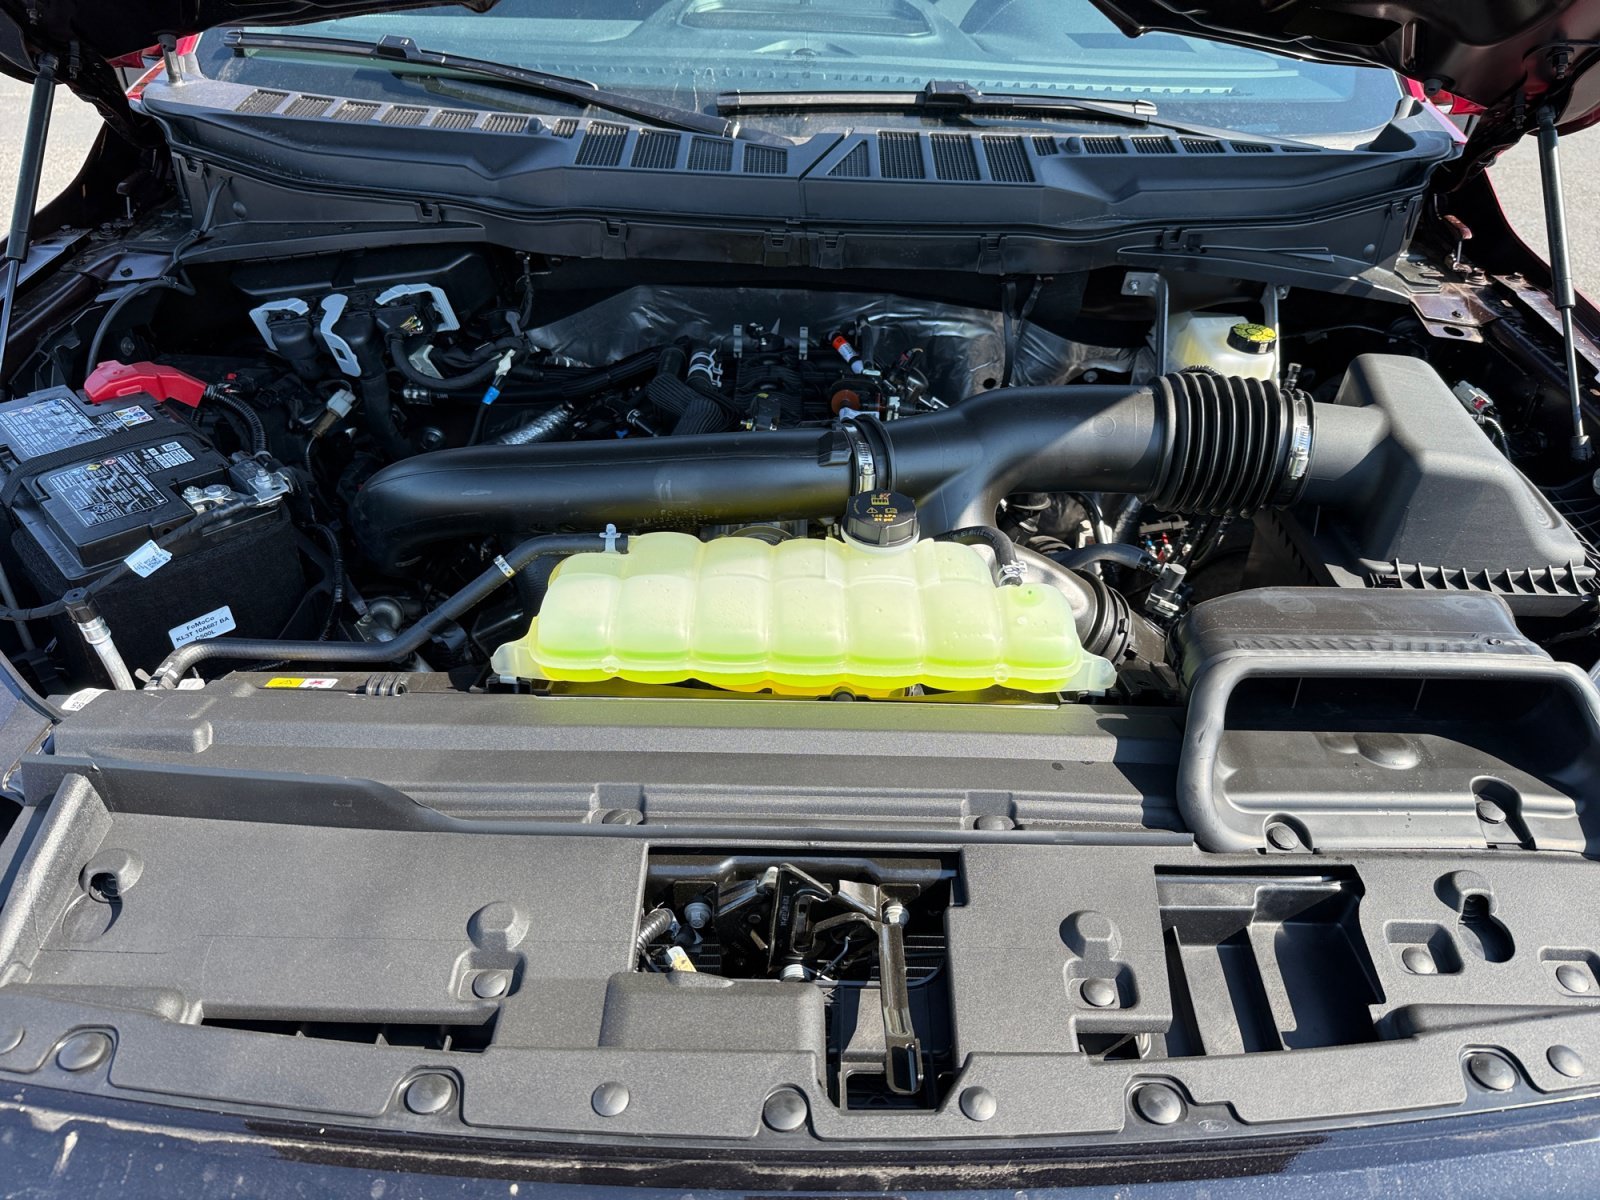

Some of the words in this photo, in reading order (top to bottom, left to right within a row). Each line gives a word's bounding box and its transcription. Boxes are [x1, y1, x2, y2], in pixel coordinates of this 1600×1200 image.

[175, 631, 193, 643] KL3T
[219, 616, 230, 624] BA
[186, 616, 215, 631] FoMoCo
